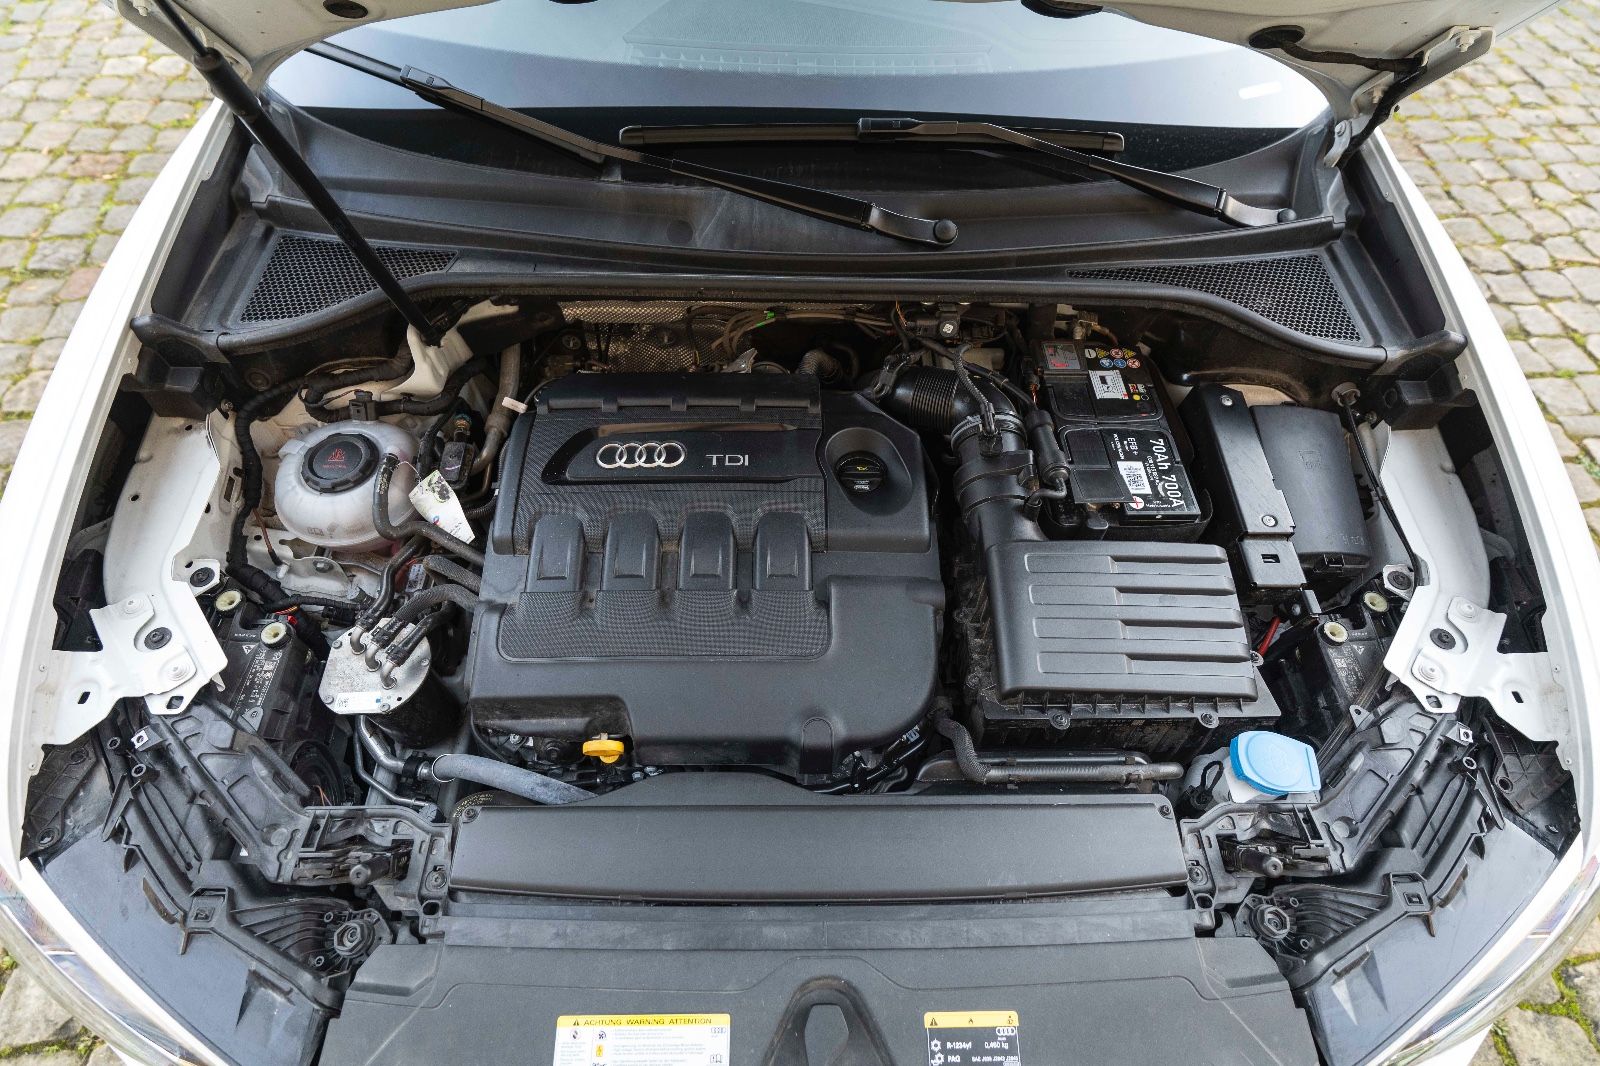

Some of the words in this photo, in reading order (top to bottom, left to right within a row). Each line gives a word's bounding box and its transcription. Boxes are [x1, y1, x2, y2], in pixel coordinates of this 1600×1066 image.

[705, 454, 749, 466] TDI
[1149, 438, 1171, 470] 70Ah
[1162, 474, 1184, 507] 700A
[947, 1055, 961, 1063] PAG
